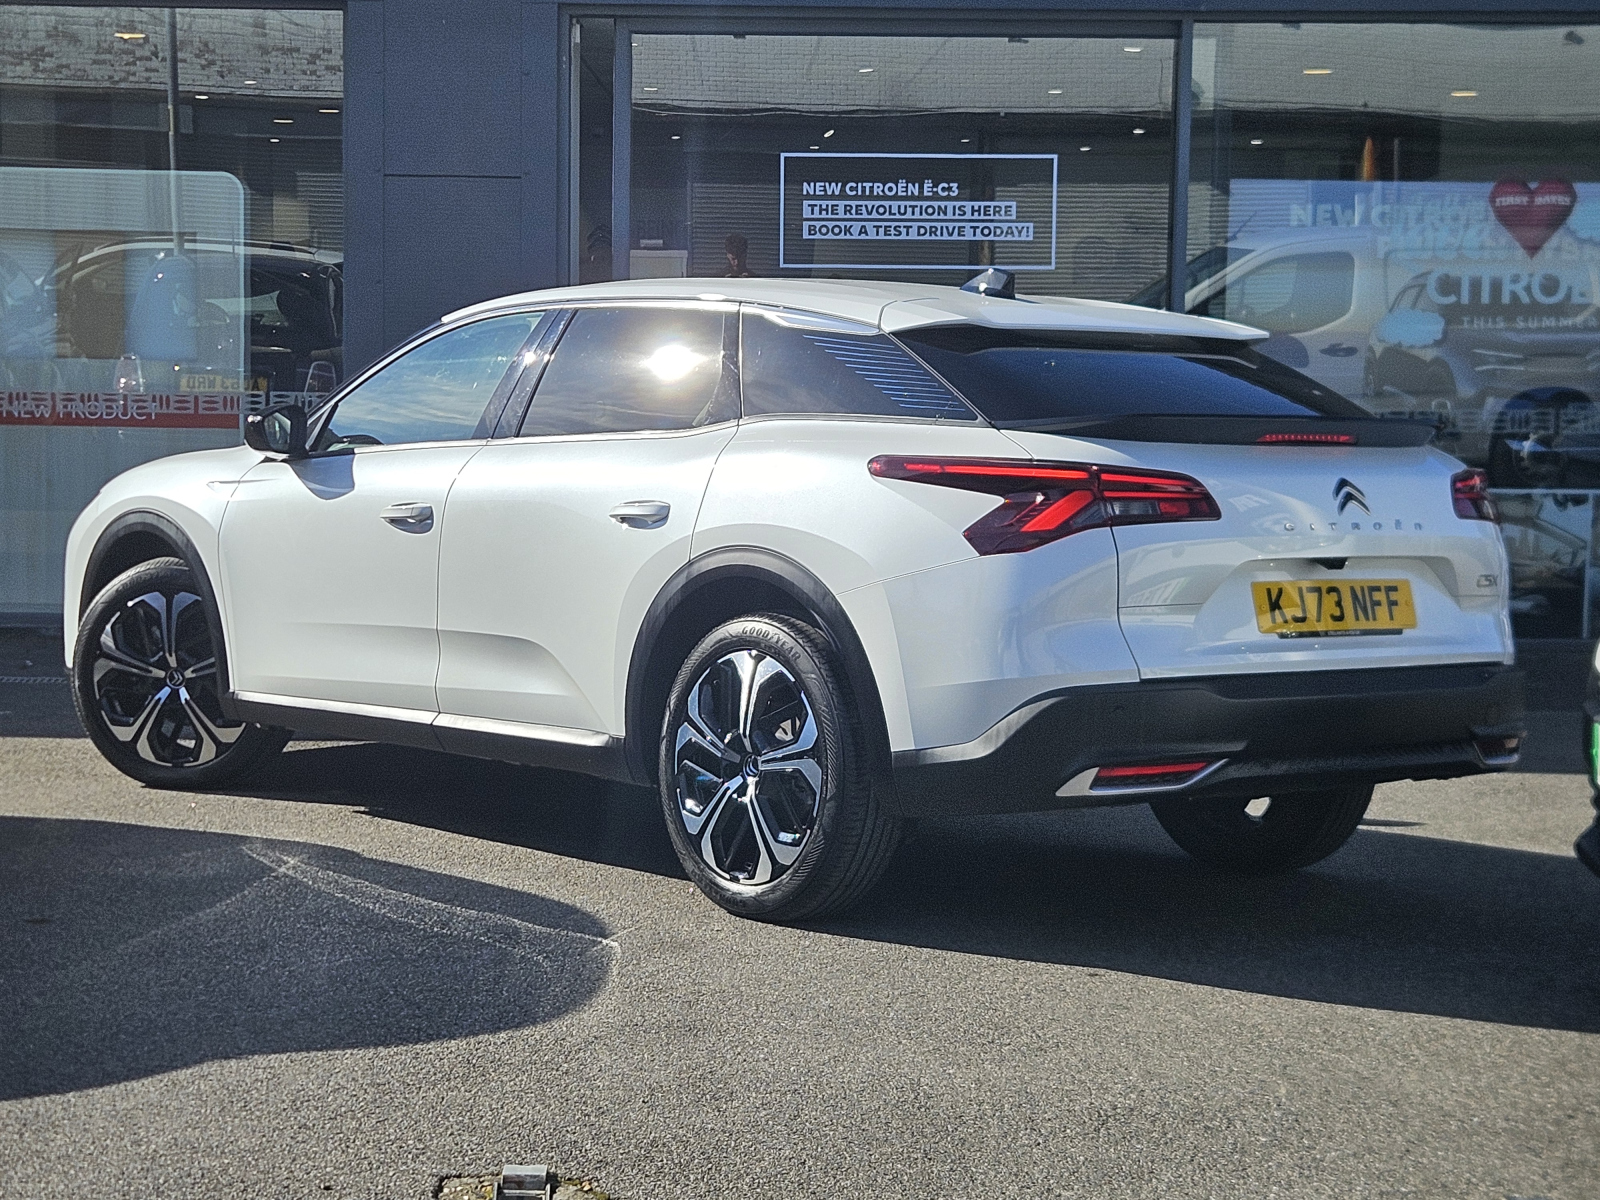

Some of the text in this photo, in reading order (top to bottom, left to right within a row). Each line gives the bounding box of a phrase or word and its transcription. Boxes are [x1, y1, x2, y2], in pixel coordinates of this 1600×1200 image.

[802, 179, 959, 197] NEW CITROËN Ë-C3
[807, 203, 1013, 218] THE REVOLUTION IS HERE
[807, 224, 1031, 239] BOOK A TEST DRIVE TODAY!
[2, 401, 157, 420] NEW PRODUCT
[1265, 585, 1399, 625] KJ73 NFF
[741, 625, 802, 662] GOODYEAR
